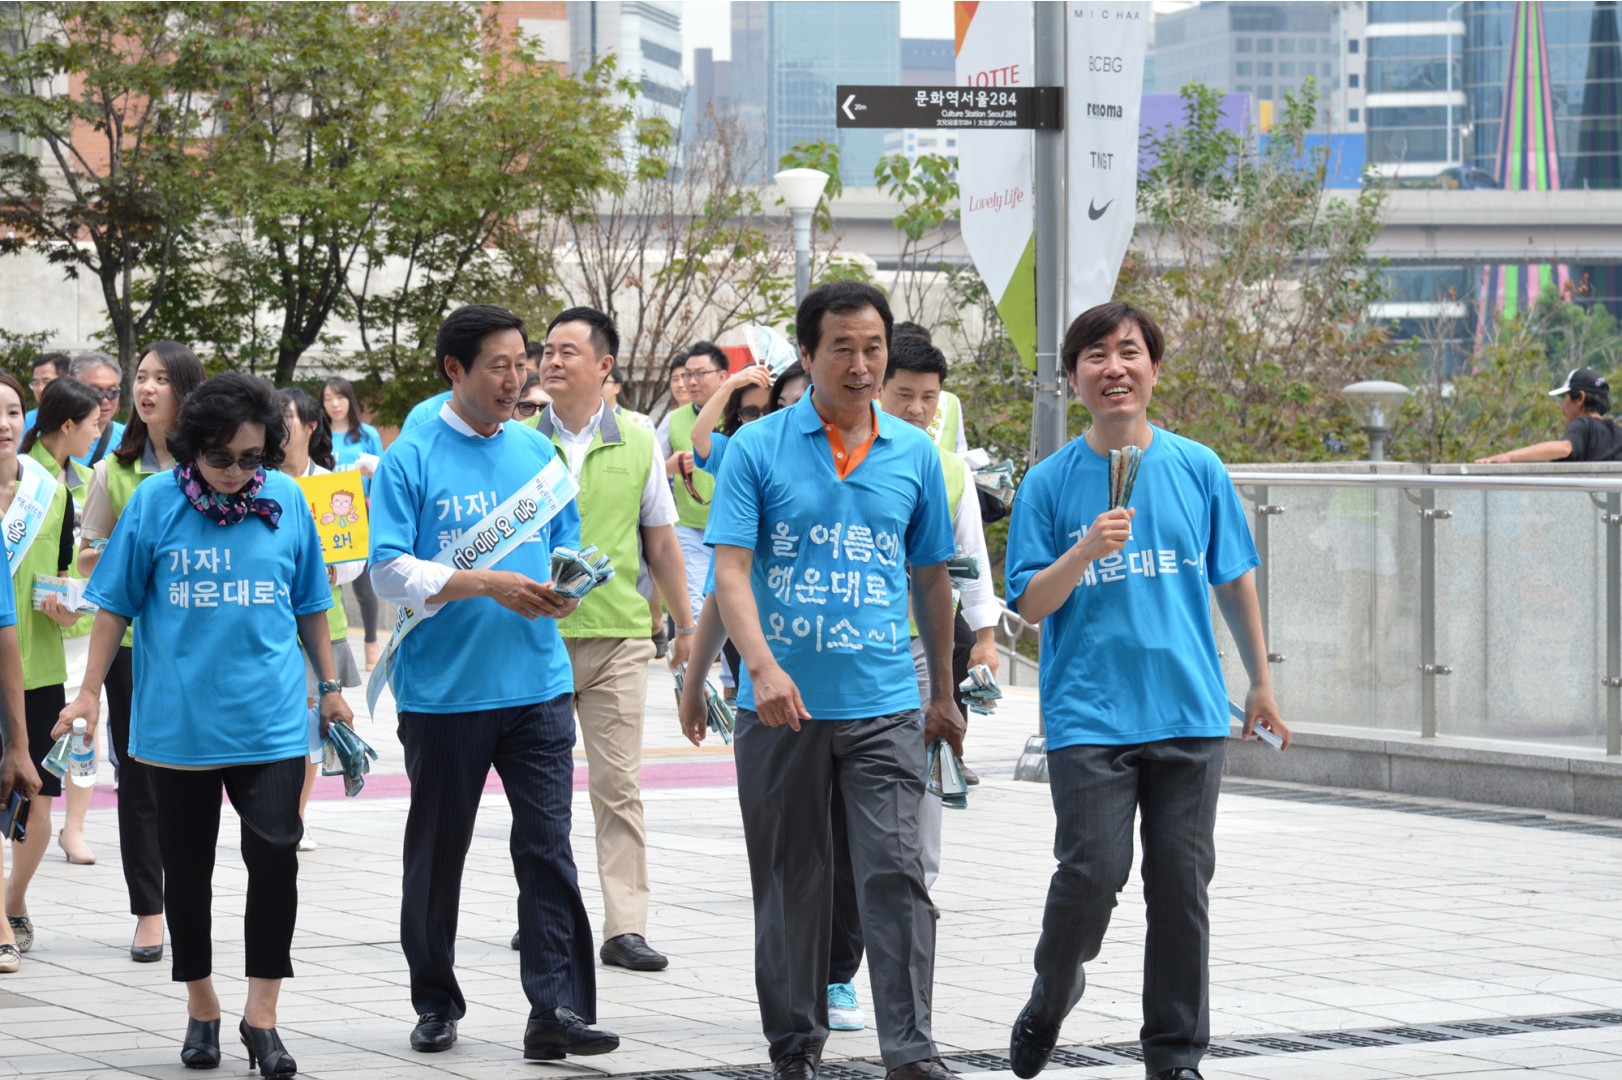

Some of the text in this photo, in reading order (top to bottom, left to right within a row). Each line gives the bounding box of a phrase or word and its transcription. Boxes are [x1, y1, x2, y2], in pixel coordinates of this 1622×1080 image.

[968, 64, 1019, 87] LOTTE
[1088, 56, 1122, 73] BCBG
[854, 103, 867, 111] 20m
[914, 90, 1017, 108] 문화역서울284
[1087, 102, 1123, 118] renoma
[941, 109, 1017, 118] Culture Station Seoul 284
[1090, 151, 1114, 170] TNGT
[969, 186, 1024, 213] Lovely Life
[436, 490, 498, 522] 가자!
[514, 498, 538, 525] 올
[8, 518, 27, 545] 올
[332, 531, 353, 550] 와!
[770, 521, 899, 567] 올 여름엔
[169, 547, 232, 575] 가자!
[767, 565, 890, 608] 해운대로
